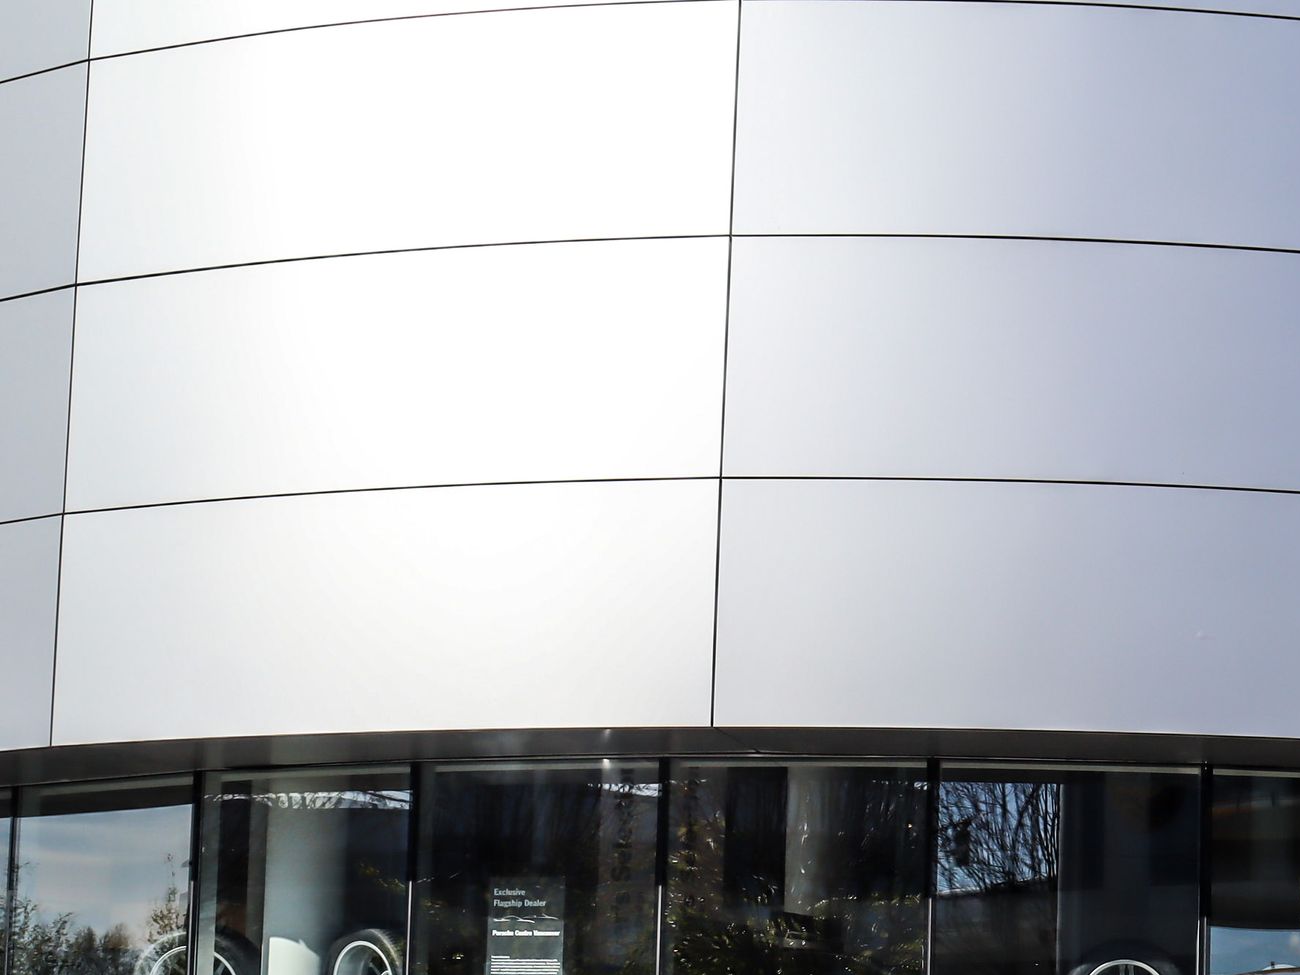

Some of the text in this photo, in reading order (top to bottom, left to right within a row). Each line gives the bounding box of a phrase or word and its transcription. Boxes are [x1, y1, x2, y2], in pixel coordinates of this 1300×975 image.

[494, 888, 526, 896] Exclusive
[493, 899, 547, 908] Flagship Dealer
